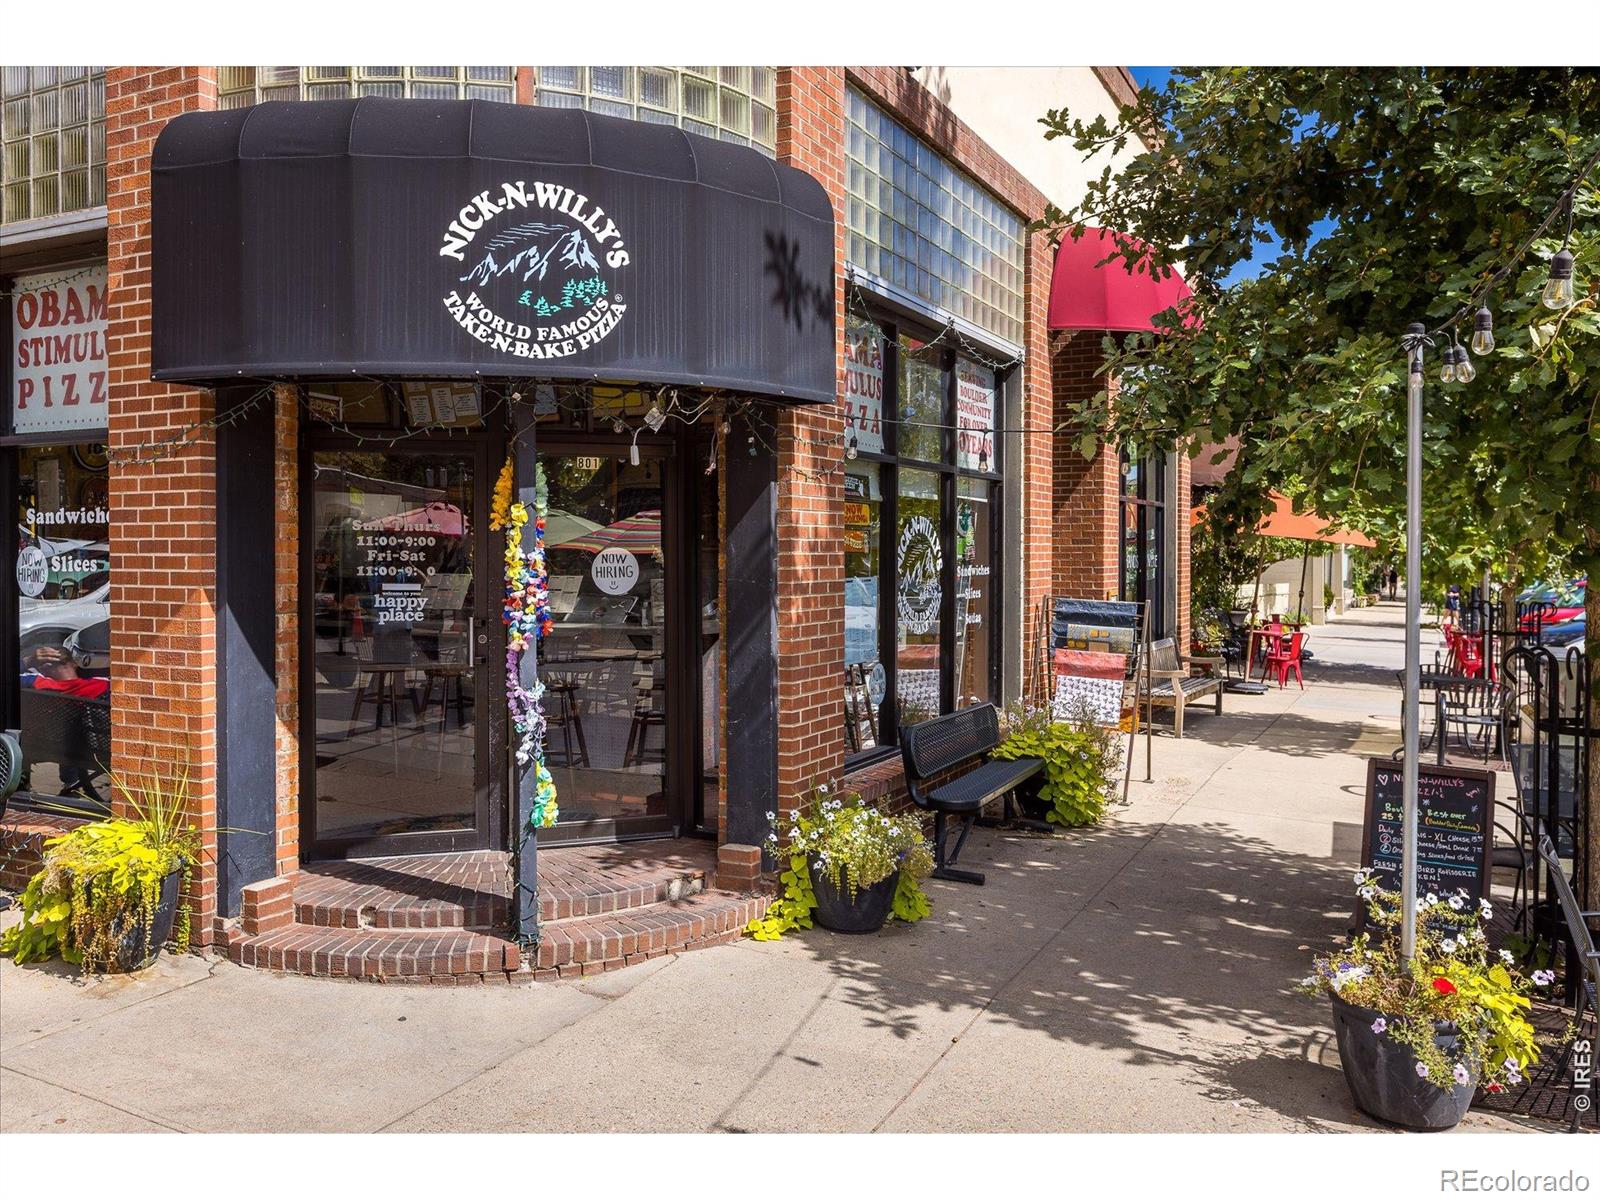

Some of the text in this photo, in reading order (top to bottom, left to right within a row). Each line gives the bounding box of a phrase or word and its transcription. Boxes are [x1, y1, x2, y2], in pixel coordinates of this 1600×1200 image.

[440, 181, 630, 269] NICK-N-WILLY'S
[465, 292, 609, 341] WORLD FAMOUS
[443, 291, 627, 359] TAKE-N-BAKE PIZZA
[18, 330, 109, 369] STIMUL
[577, 458, 599, 469] 801
[356, 536, 436, 547] 11:00-9:00
[22, 553, 43, 566] NOW
[367, 549, 426, 561] Fri-Sat
[601, 554, 627, 564] NOW
[51, 556, 97, 572] Slices
[956, 565, 990, 577] Sandwiches
[18, 568, 45, 583] HIRING
[356, 566, 436, 577] 11:00-9:0
[595, 565, 634, 579] HIRING
[374, 594, 428, 611] happy
[379, 609, 424, 625] place
